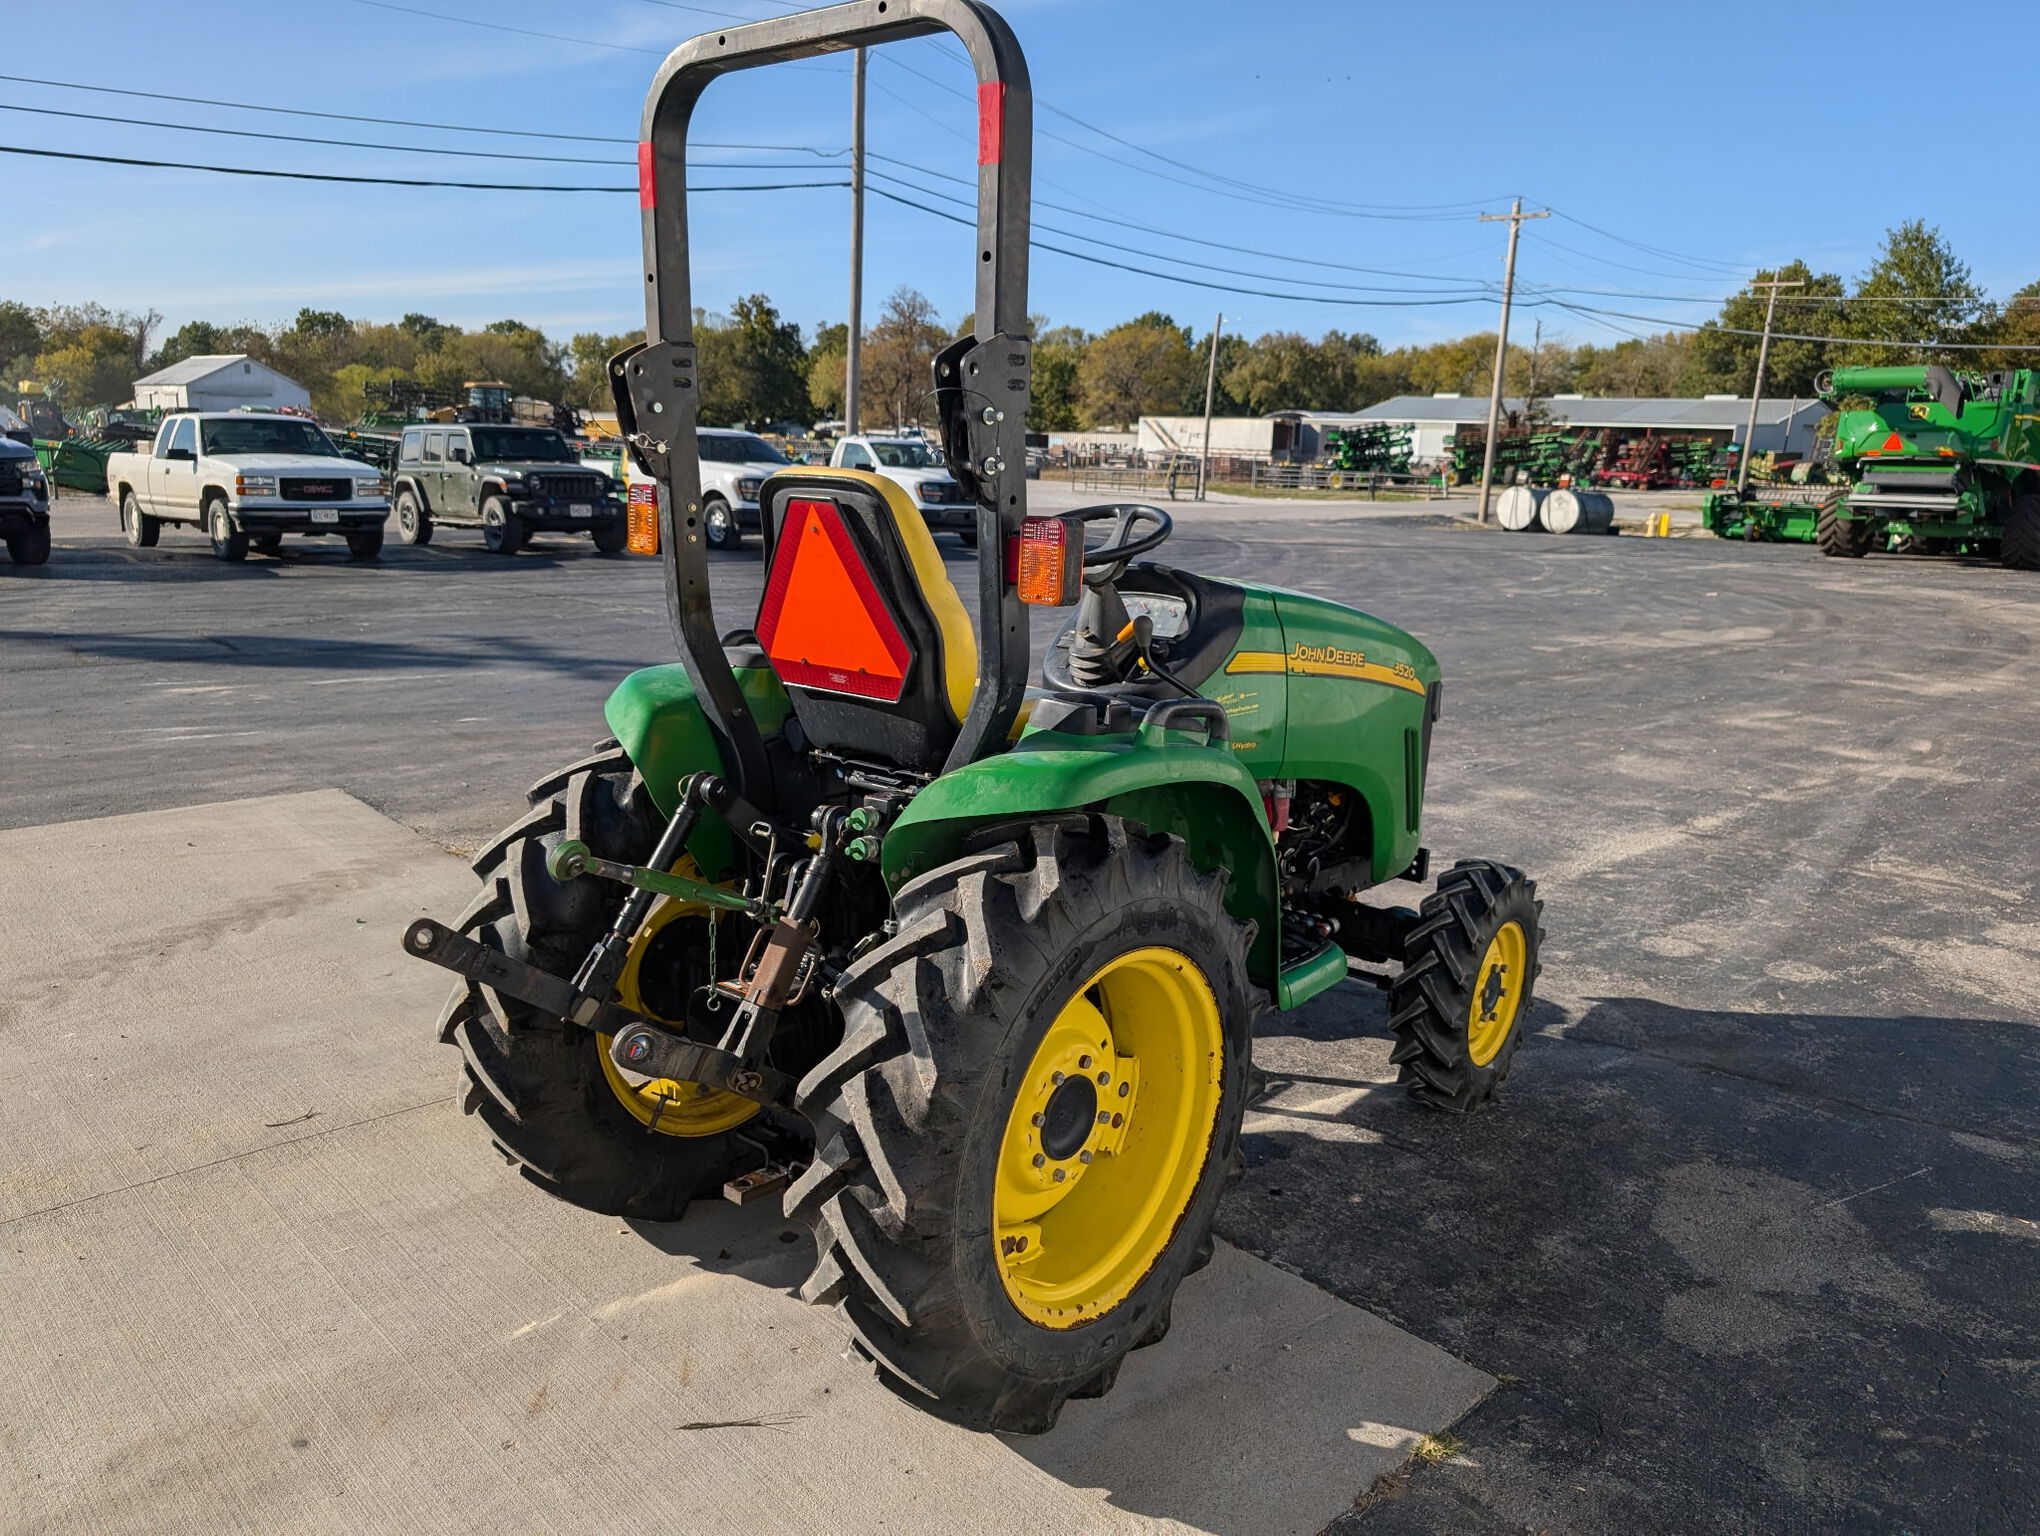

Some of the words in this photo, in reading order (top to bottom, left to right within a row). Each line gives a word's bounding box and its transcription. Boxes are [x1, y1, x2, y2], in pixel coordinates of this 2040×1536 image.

[303, 485, 334, 494] GMC
[1290, 641, 1327, 662] JOHN
[1326, 646, 1366, 667] DEERE
[1393, 662, 1416, 680] 3520
